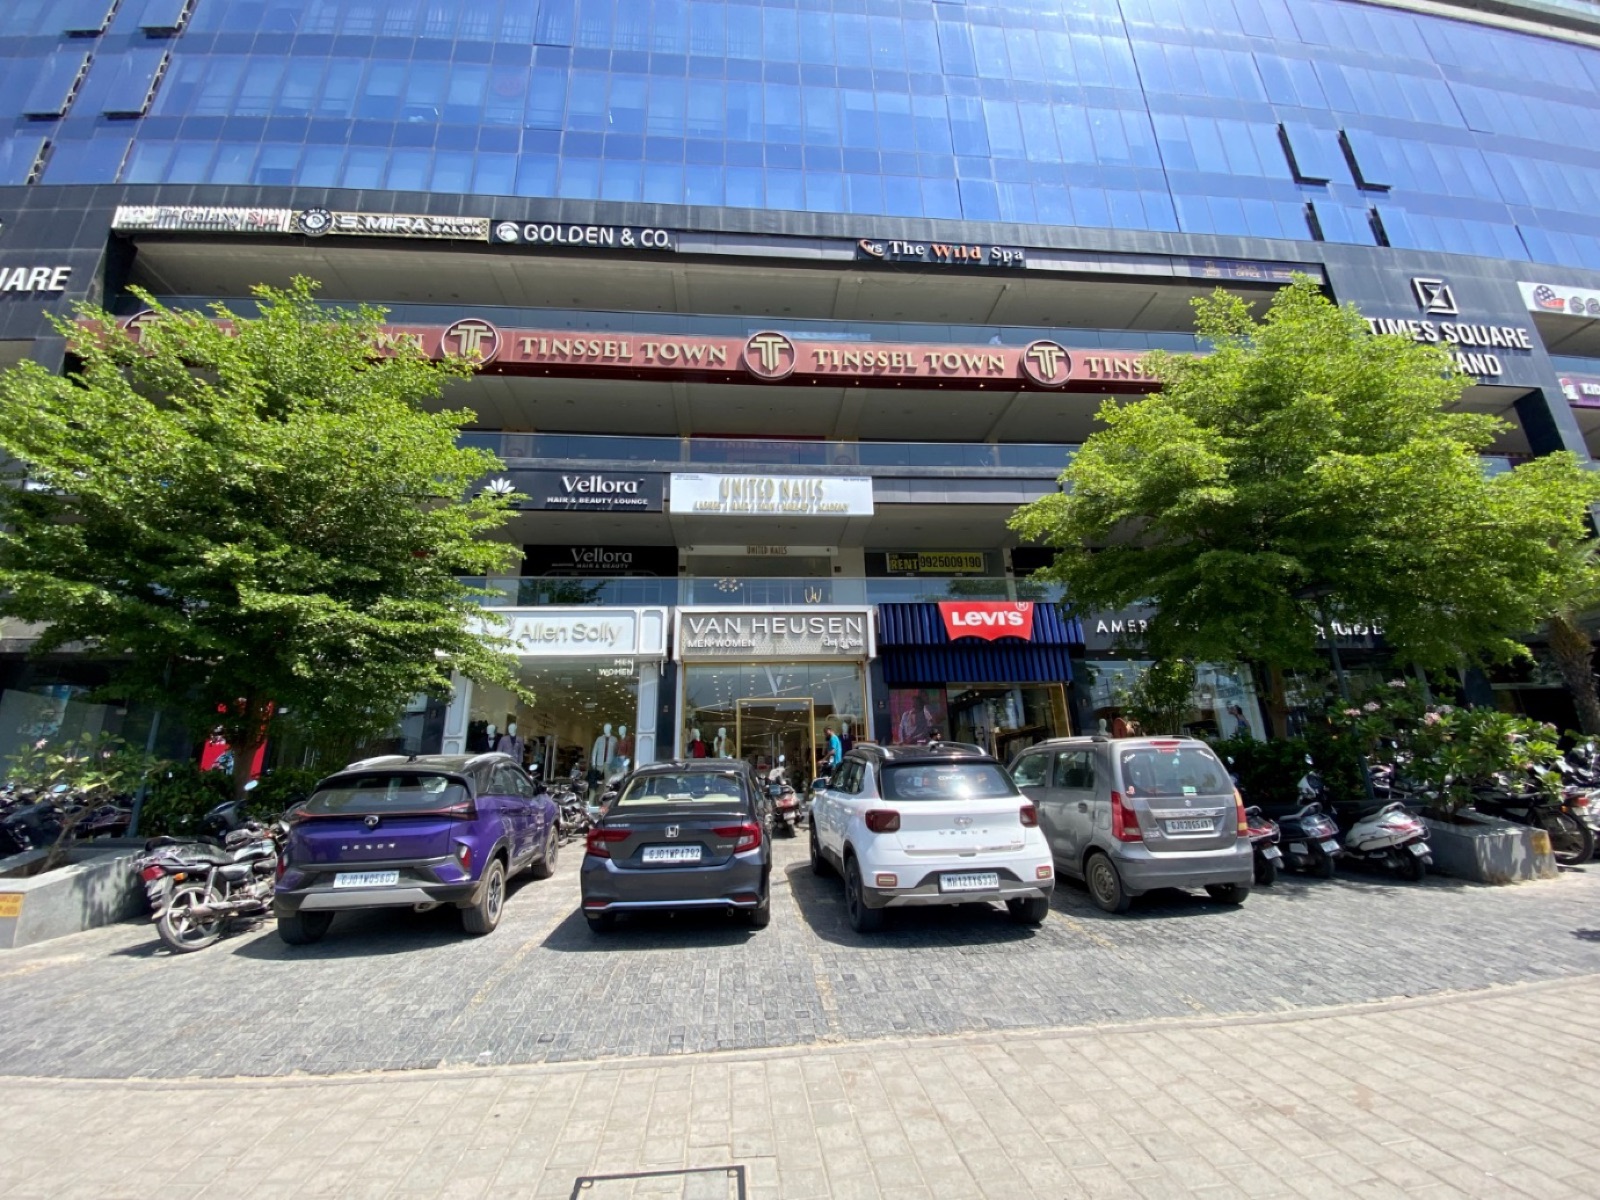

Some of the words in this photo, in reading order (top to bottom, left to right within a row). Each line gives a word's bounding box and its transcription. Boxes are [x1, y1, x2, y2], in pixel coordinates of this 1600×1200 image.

[524, 224, 614, 245] GOLDEN
[620, 228, 636, 247] &
[641, 230, 672, 248] CO.
[888, 241, 925, 256] The
[930, 244, 982, 260] Wild
[990, 246, 1024, 262] Spa
[1440, 322, 1534, 349] SQUARE
[521, 336, 633, 360] TINSSEL
[642, 342, 728, 363] TOWN
[813, 349, 918, 370] TINSSEL
[924, 353, 1005, 372] TOWN
[562, 475, 638, 493] Vellora
[720, 478, 774, 499] UNITED
[779, 479, 823, 500] NAILS
[571, 547, 633, 563] Vellora
[746, 546, 770, 556] UNITED
[772, 546, 787, 556] NAILS
[890, 559, 918, 570] RENT
[520, 622, 567, 643] Allen
[572, 623, 622, 647] Solly
[689, 617, 741, 634] VAN
[752, 617, 863, 634] HEUSEN
[598, 668, 633, 677] WOMEN
[614, 659, 633, 667] MEN
